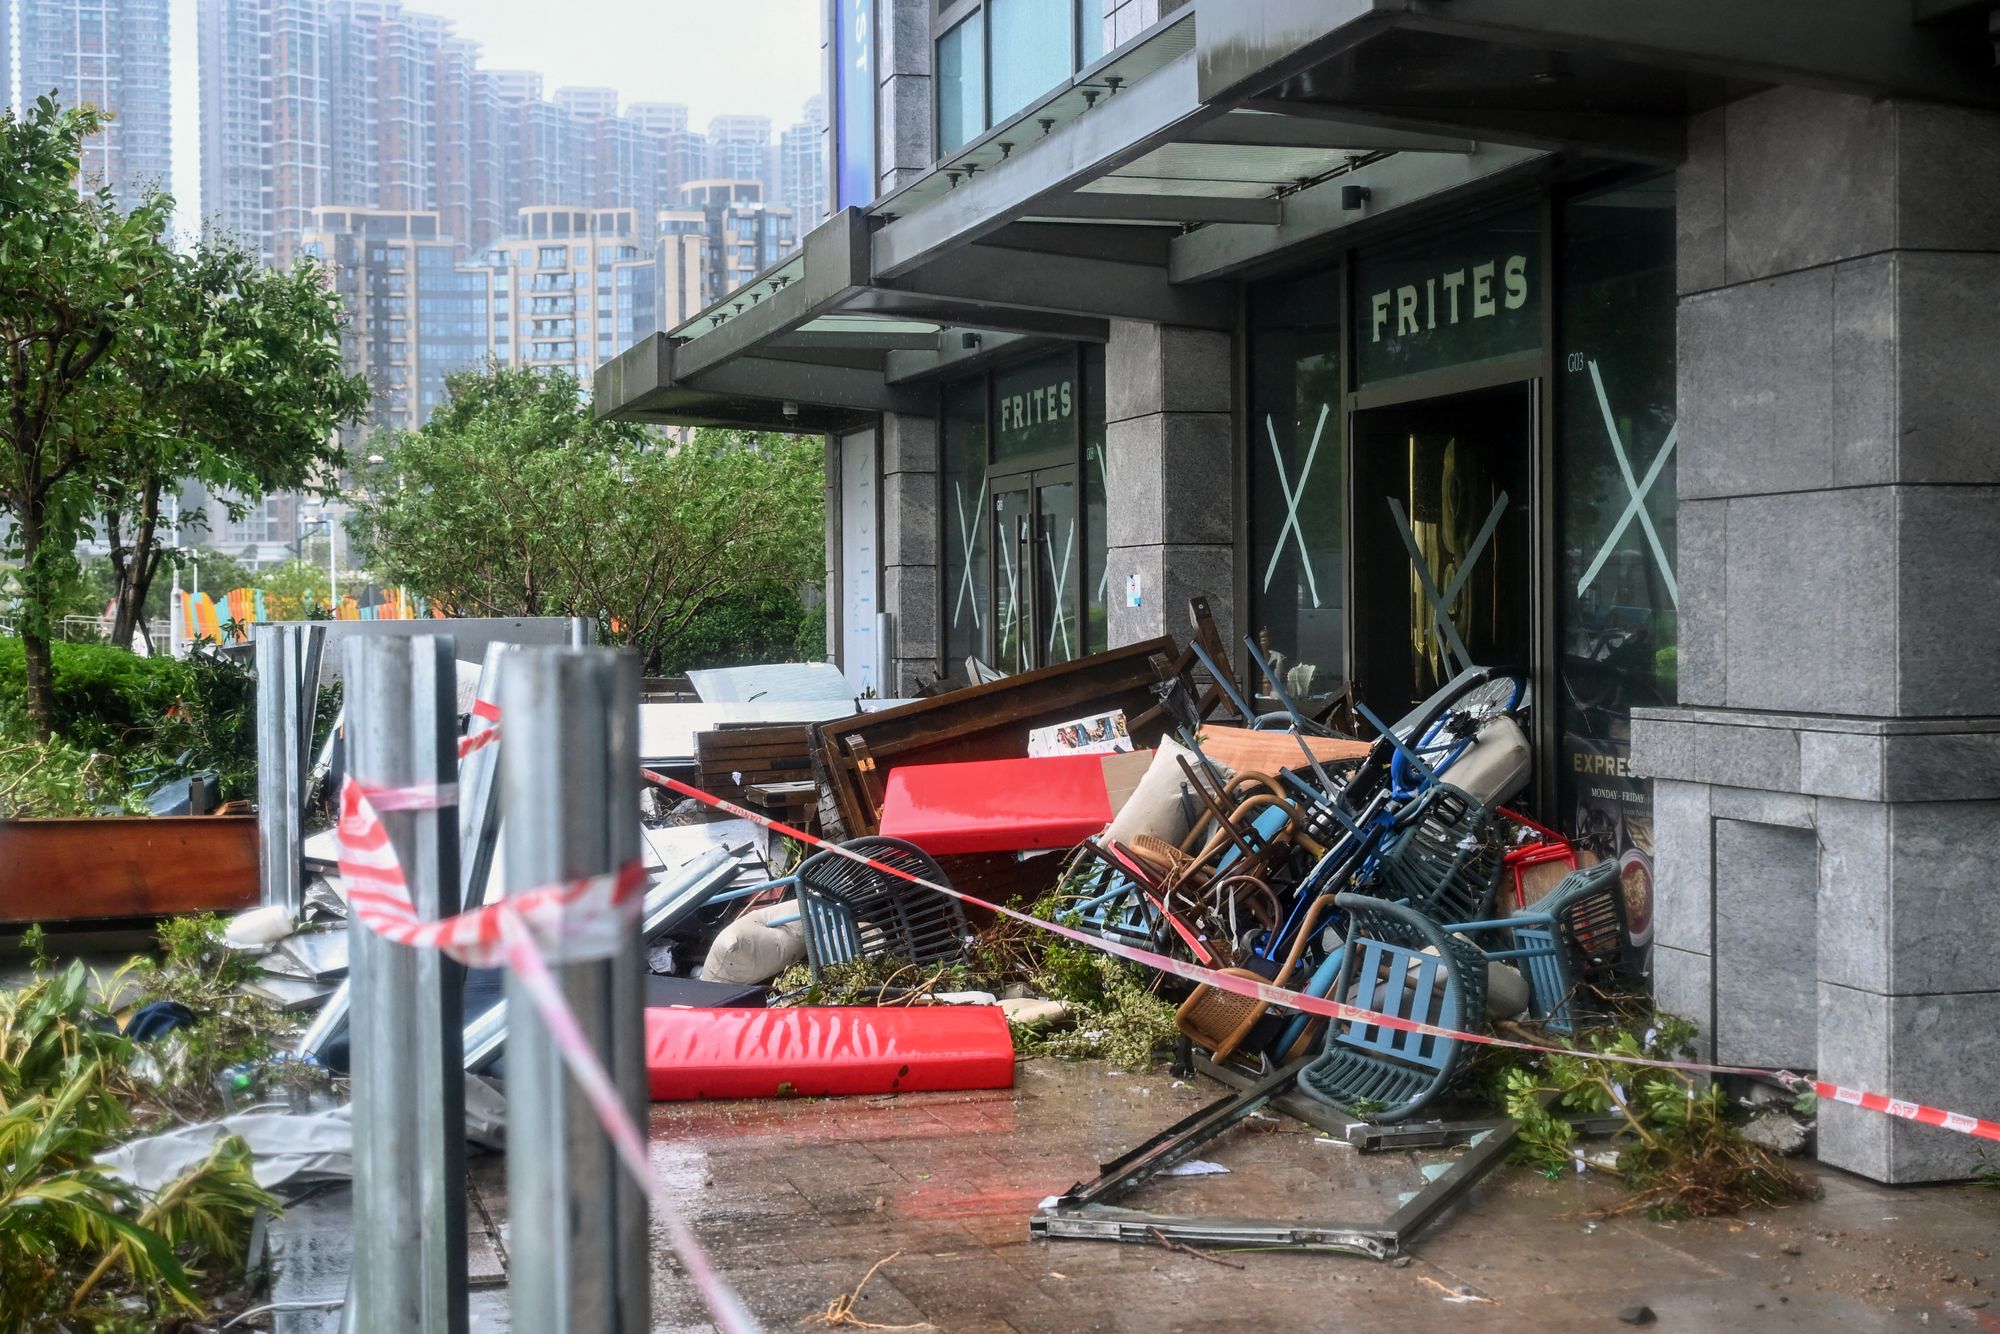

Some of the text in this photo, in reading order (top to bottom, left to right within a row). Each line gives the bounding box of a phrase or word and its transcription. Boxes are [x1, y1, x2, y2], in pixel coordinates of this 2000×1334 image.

[1371, 255, 1528, 343] FRITES
[1567, 352, 1584, 373] G03
[1001, 381, 1072, 432] FRITES
[1573, 753, 1647, 779] EXPRE
[1591, 787, 1617, 800] MONDAY
[1622, 791, 1645, 803] FRIDAY
[1839, 1089, 1860, 1101] DANGER
[1951, 1115, 1974, 1129] DANGER
